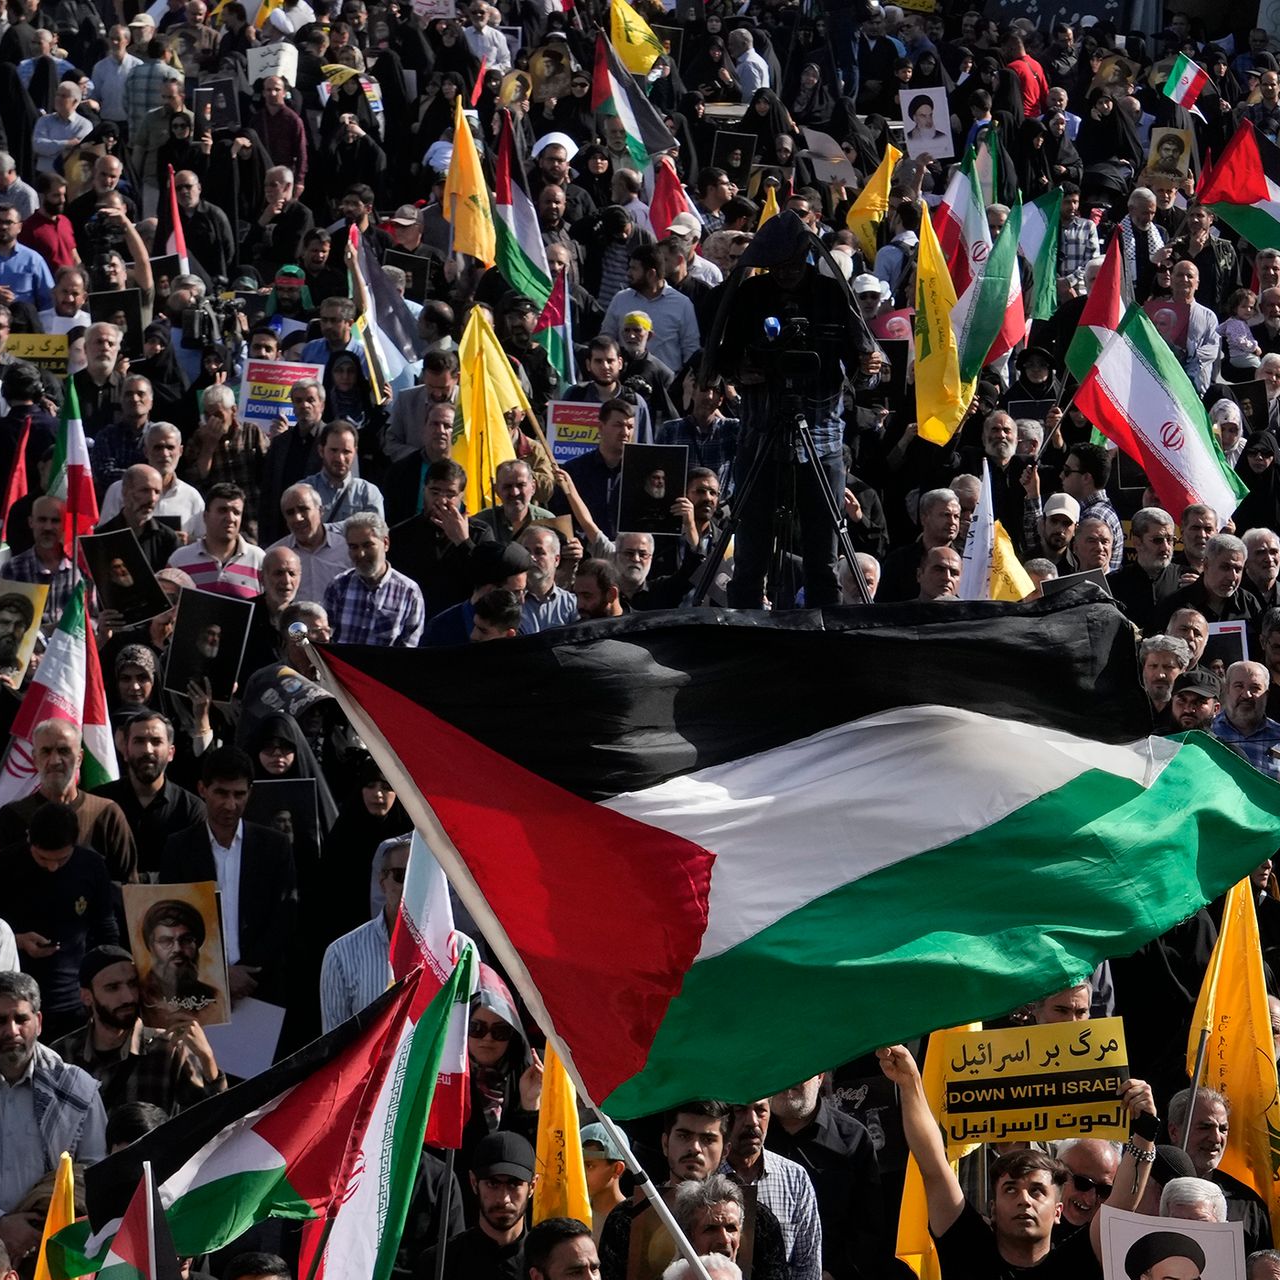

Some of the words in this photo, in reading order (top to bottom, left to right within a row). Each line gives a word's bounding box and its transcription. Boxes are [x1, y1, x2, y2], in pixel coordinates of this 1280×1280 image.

[247, 404, 277, 414] DOWN
[554, 446, 583, 455] DOWN
[951, 1039, 1030, 1075] اسرائیل
[1069, 1028, 1120, 1063] مرگ
[1039, 1048, 1061, 1067] بر
[949, 1087, 1006, 1105] DOWN
[1010, 1082, 1057, 1099] WITH
[1055, 1105, 1128, 1133] الموت
